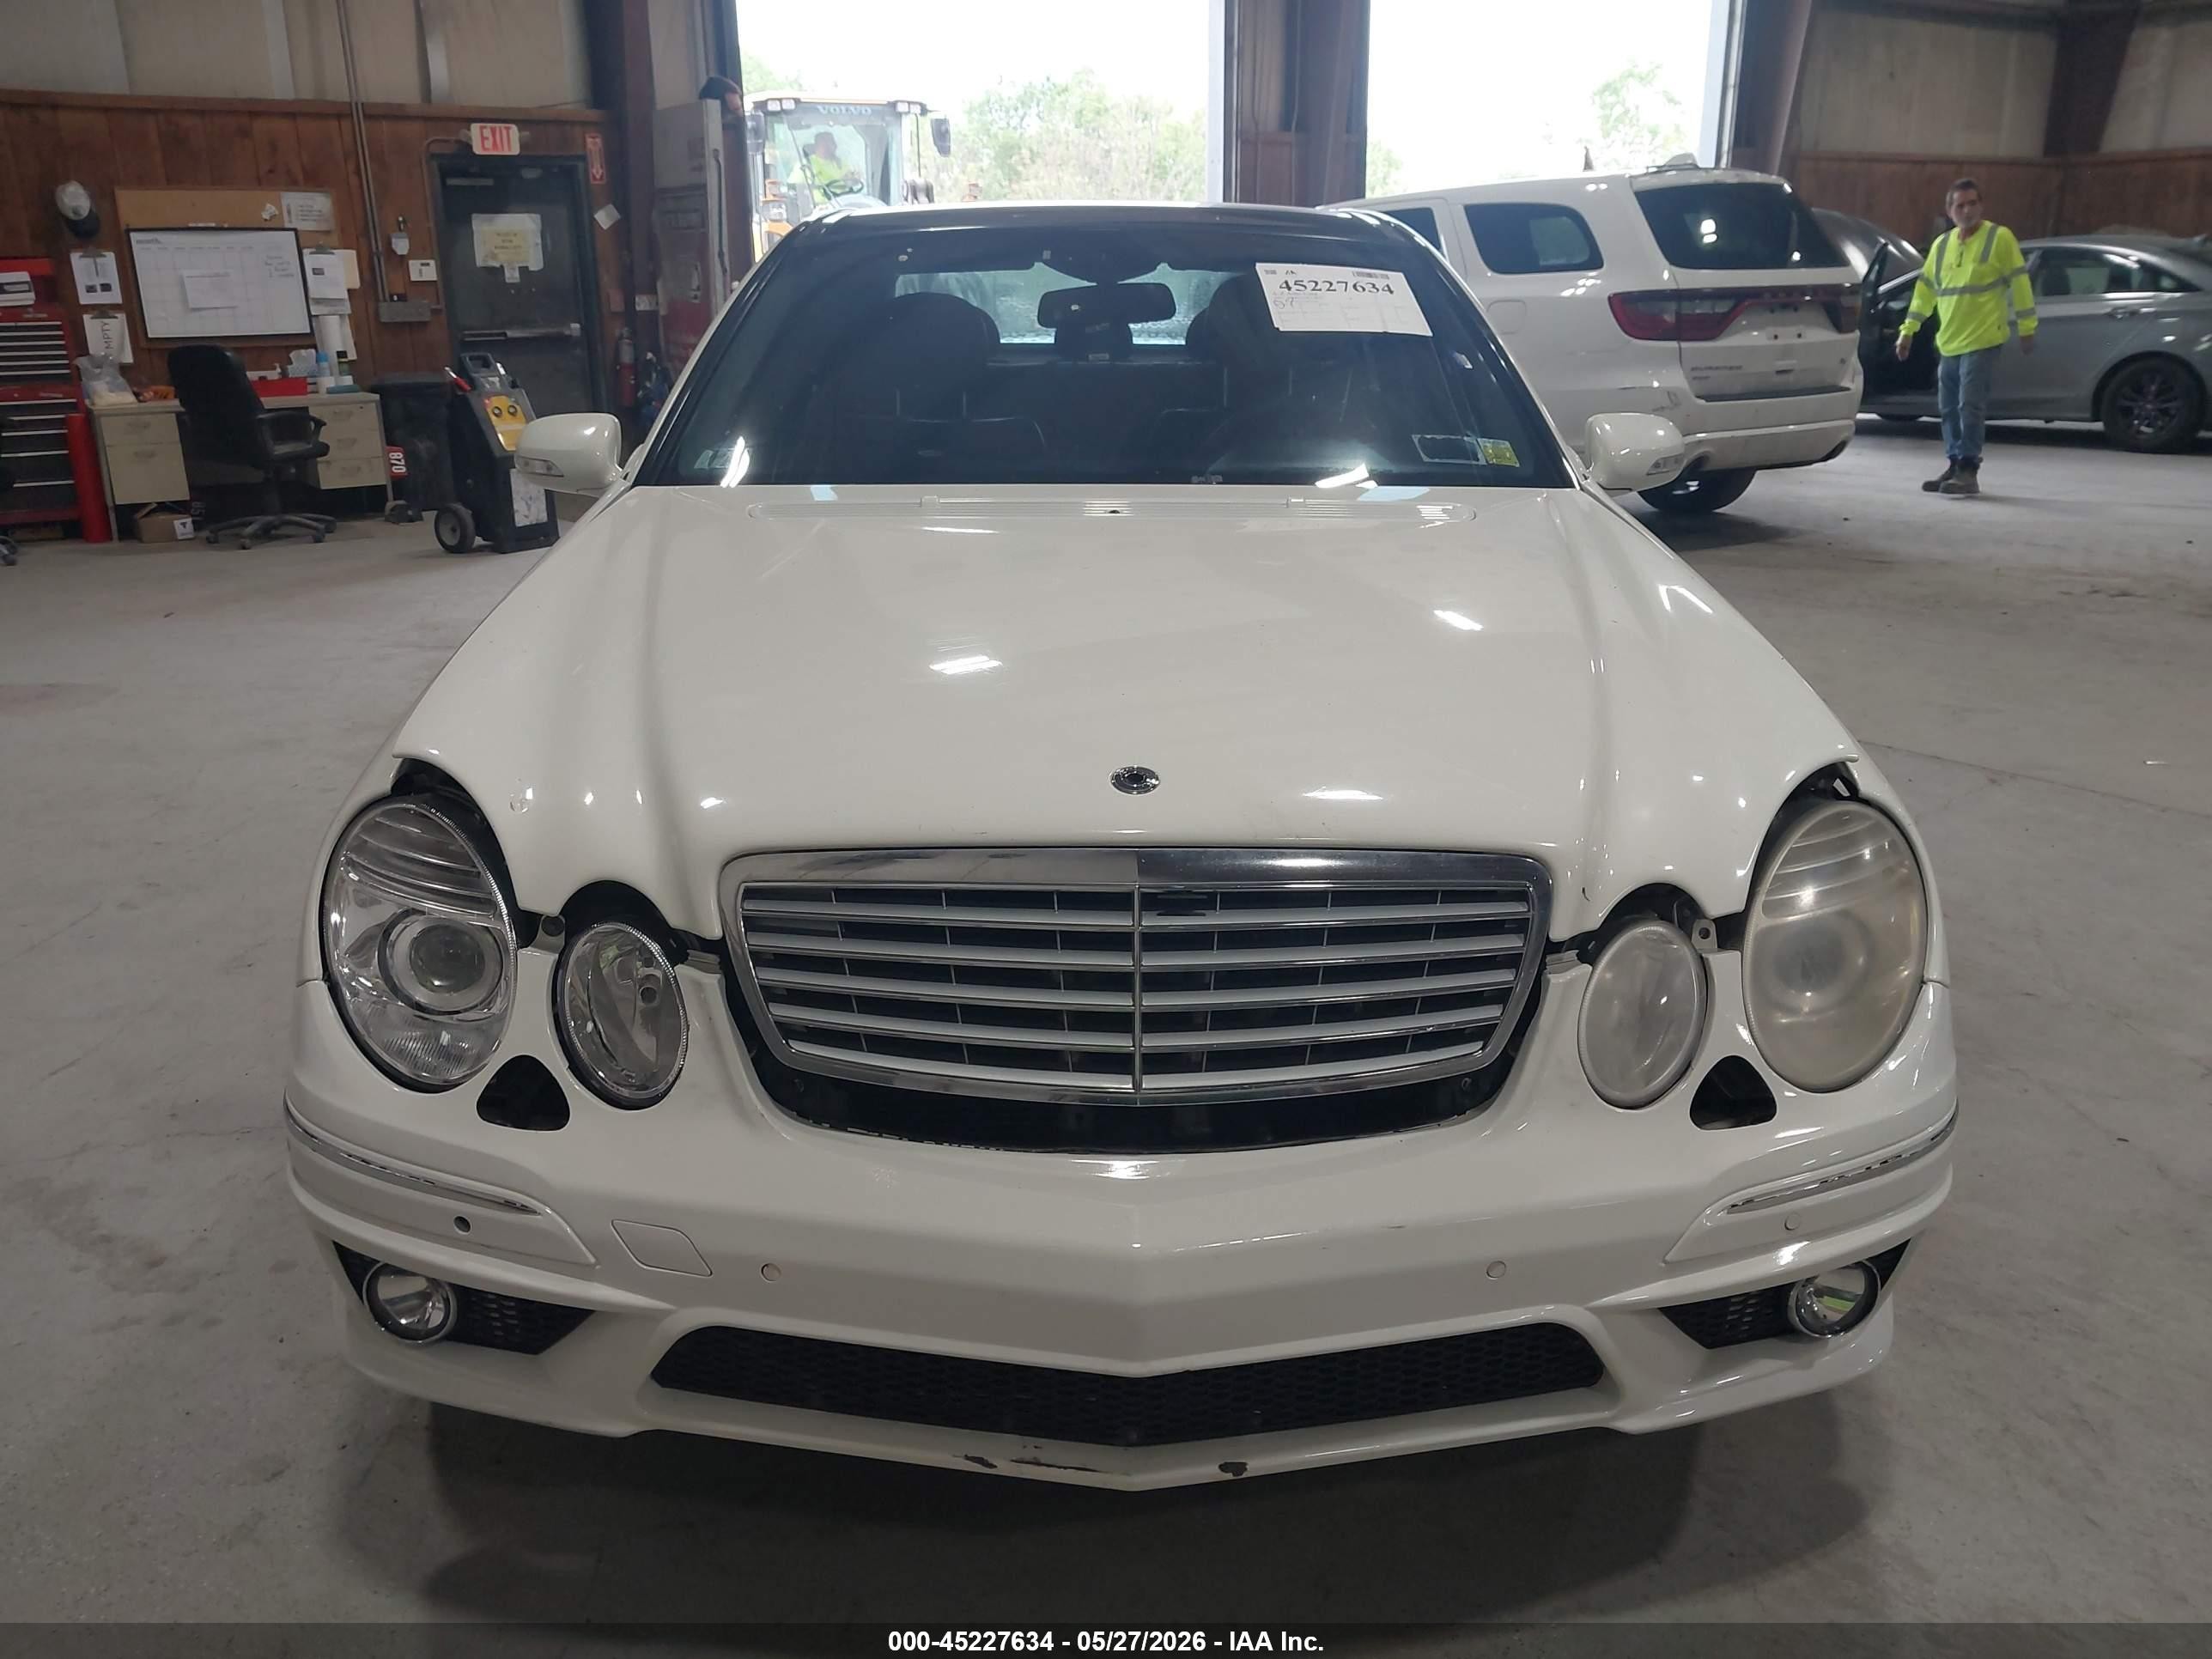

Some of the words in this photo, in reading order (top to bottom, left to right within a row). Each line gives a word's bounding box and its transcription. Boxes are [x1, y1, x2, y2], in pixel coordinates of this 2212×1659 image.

[817, 105, 872, 115] VOLVO
[479, 125, 514, 152] EXIT
[1279, 280, 1395, 295] 45227634
[389, 453, 406, 472] 870
